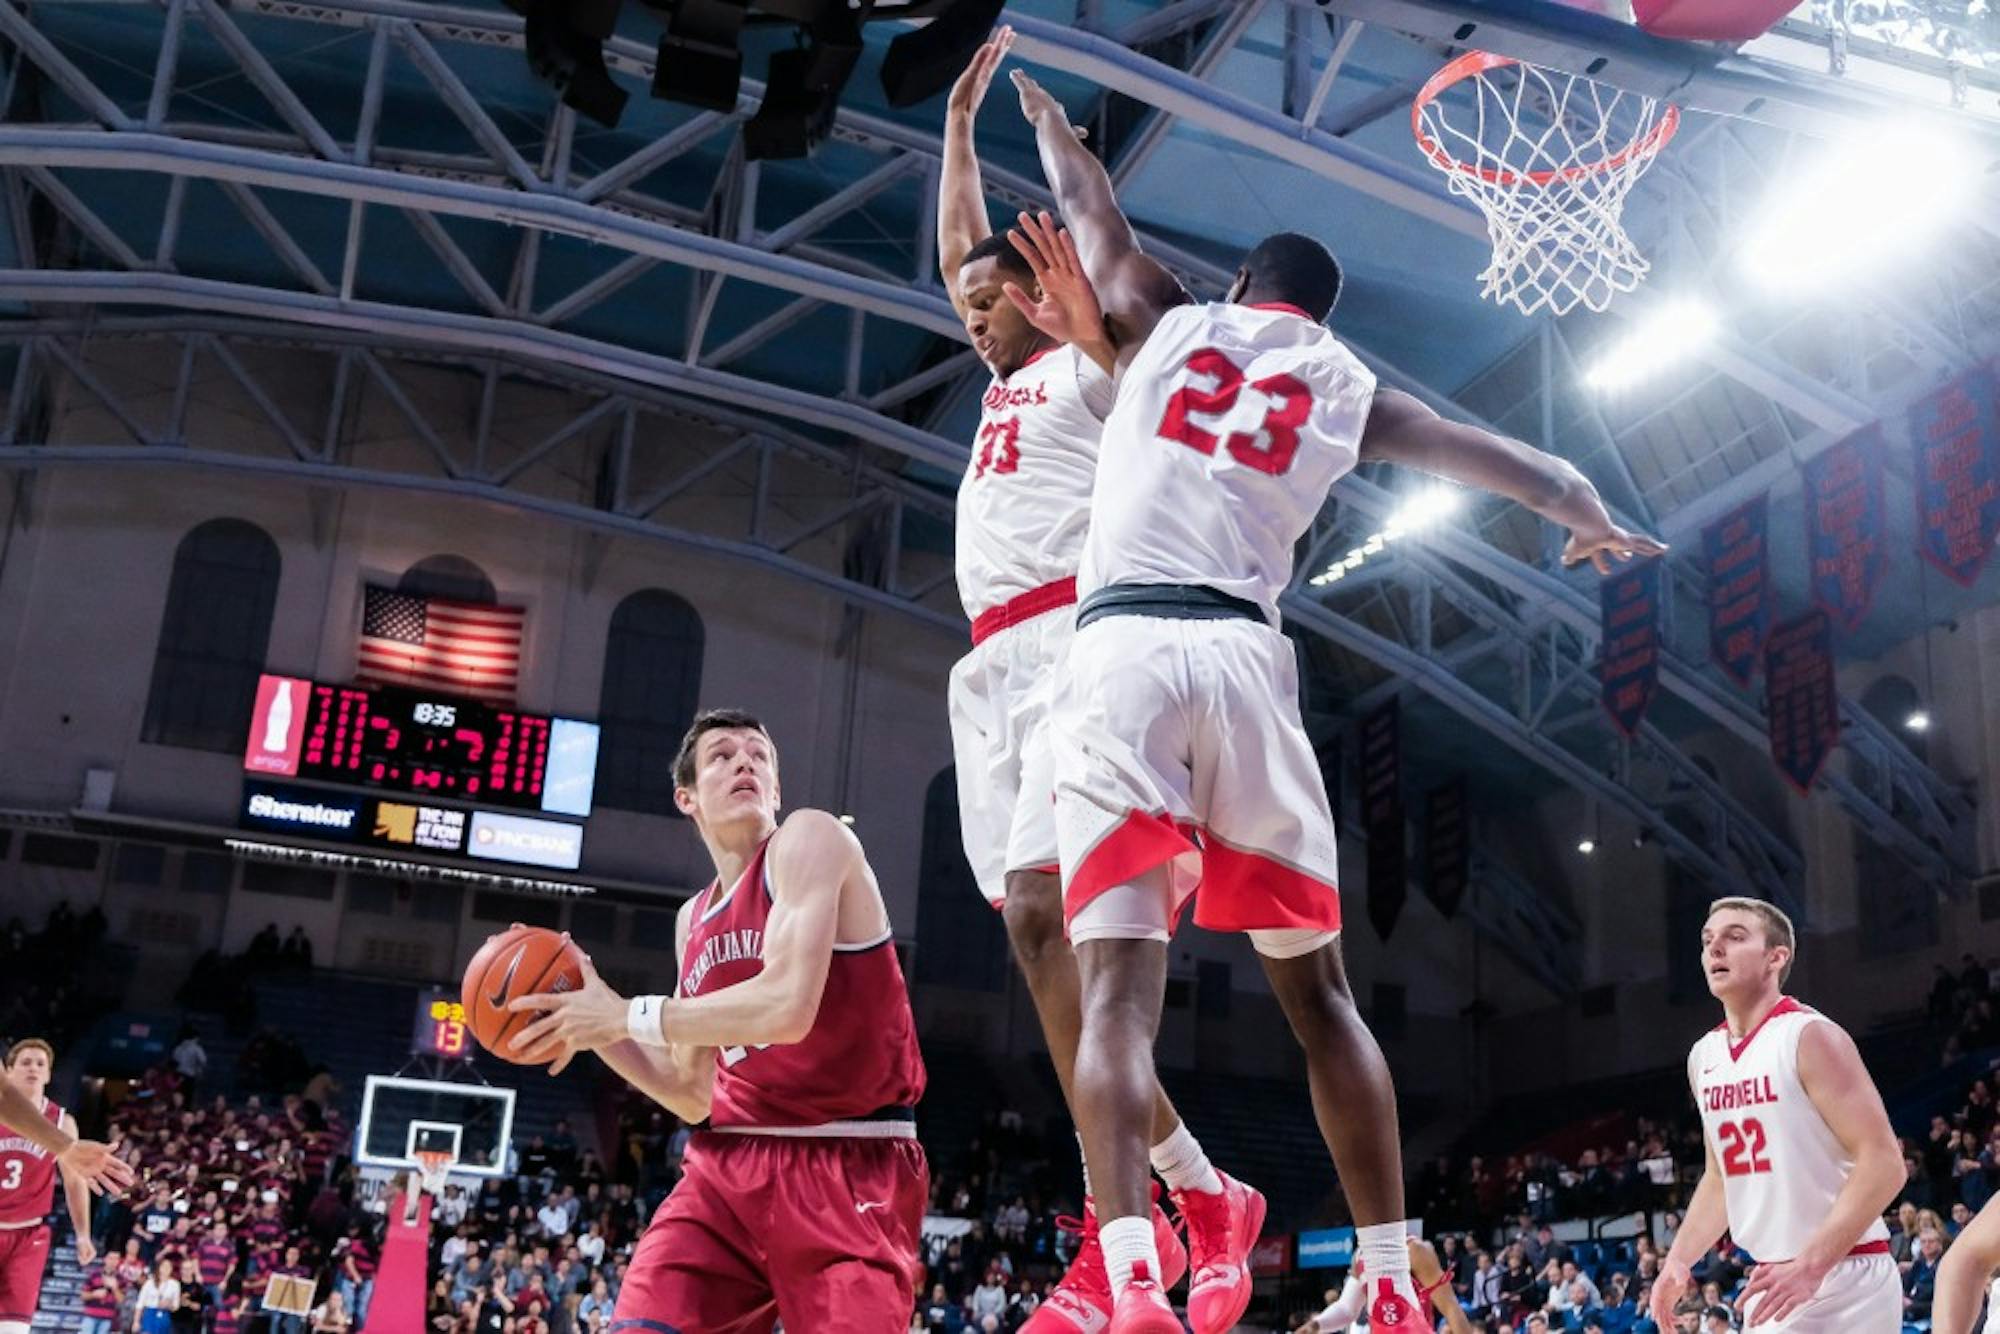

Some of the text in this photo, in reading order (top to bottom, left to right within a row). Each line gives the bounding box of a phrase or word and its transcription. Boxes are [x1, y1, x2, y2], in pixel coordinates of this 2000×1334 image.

[1156, 346, 1314, 477] 23
[248, 794, 356, 828] Sheraton
[436, 1021, 465, 1052] 13
[1718, 1116, 1773, 1178] 22
[0, 1159, 24, 1190] 3
